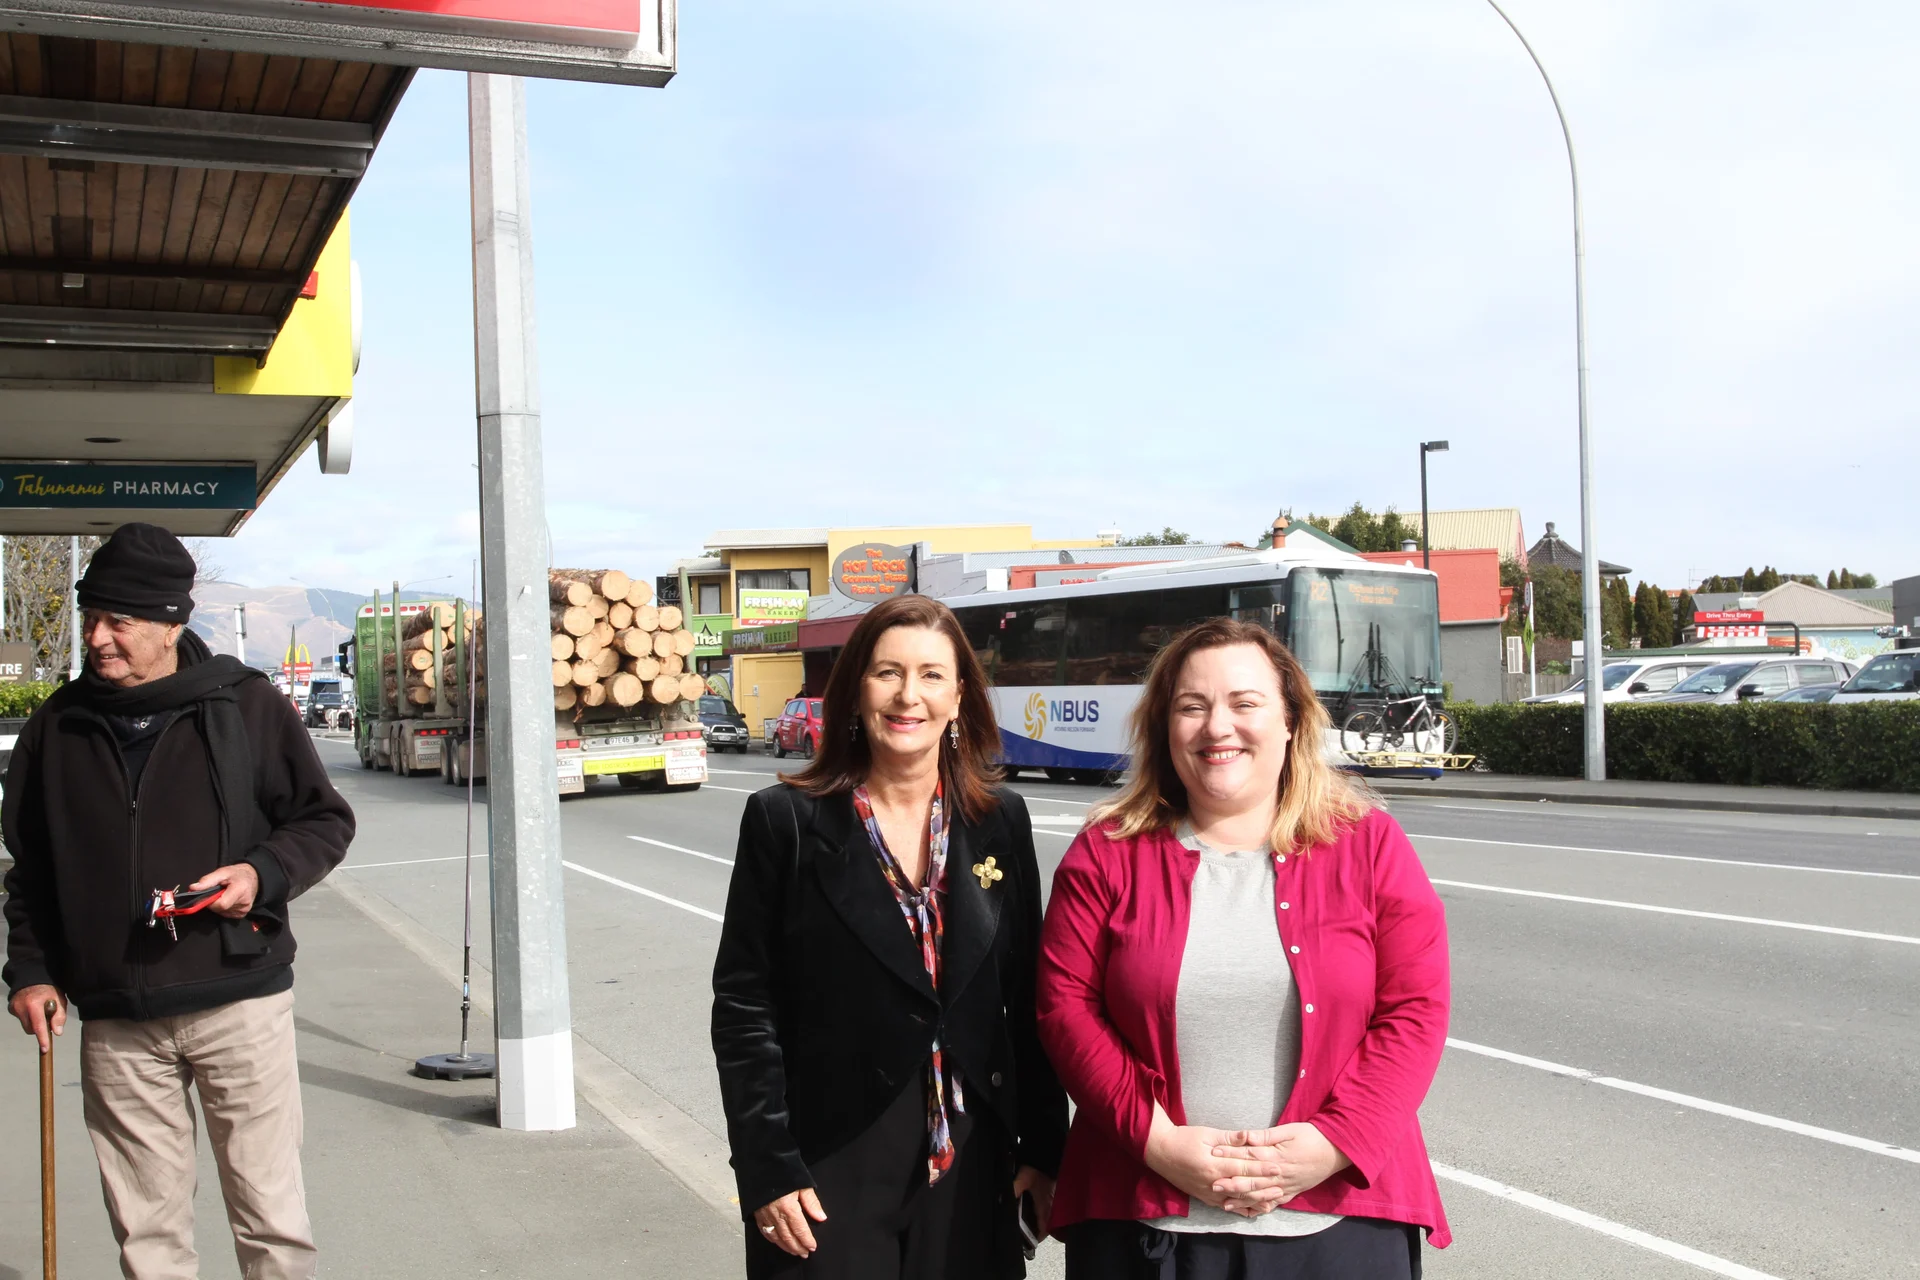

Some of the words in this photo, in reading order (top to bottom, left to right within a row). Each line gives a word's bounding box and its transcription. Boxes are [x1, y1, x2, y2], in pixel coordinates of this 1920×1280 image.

[13, 474, 105, 496] Tahunanui
[113, 480, 219, 496] PHARMACY
[865, 548, 883, 558] The
[842, 559, 868, 573] HOT
[872, 559, 907, 573] ROCK
[841, 573, 882, 584] Gourmet
[884, 572, 909, 583] Pizza
[850, 584, 876, 595] Pasta
[879, 583, 896, 594] Bar
[1310, 581, 1328, 601] R2
[744, 596, 782, 611] FRESH
[790, 596, 805, 613] AS
[693, 631, 723, 645] Thai
[733, 631, 754, 650] FRESH
[765, 630, 791, 644] BAKERY
[1050, 700, 1099, 722] NBUS
[653, 757, 663, 767] H
